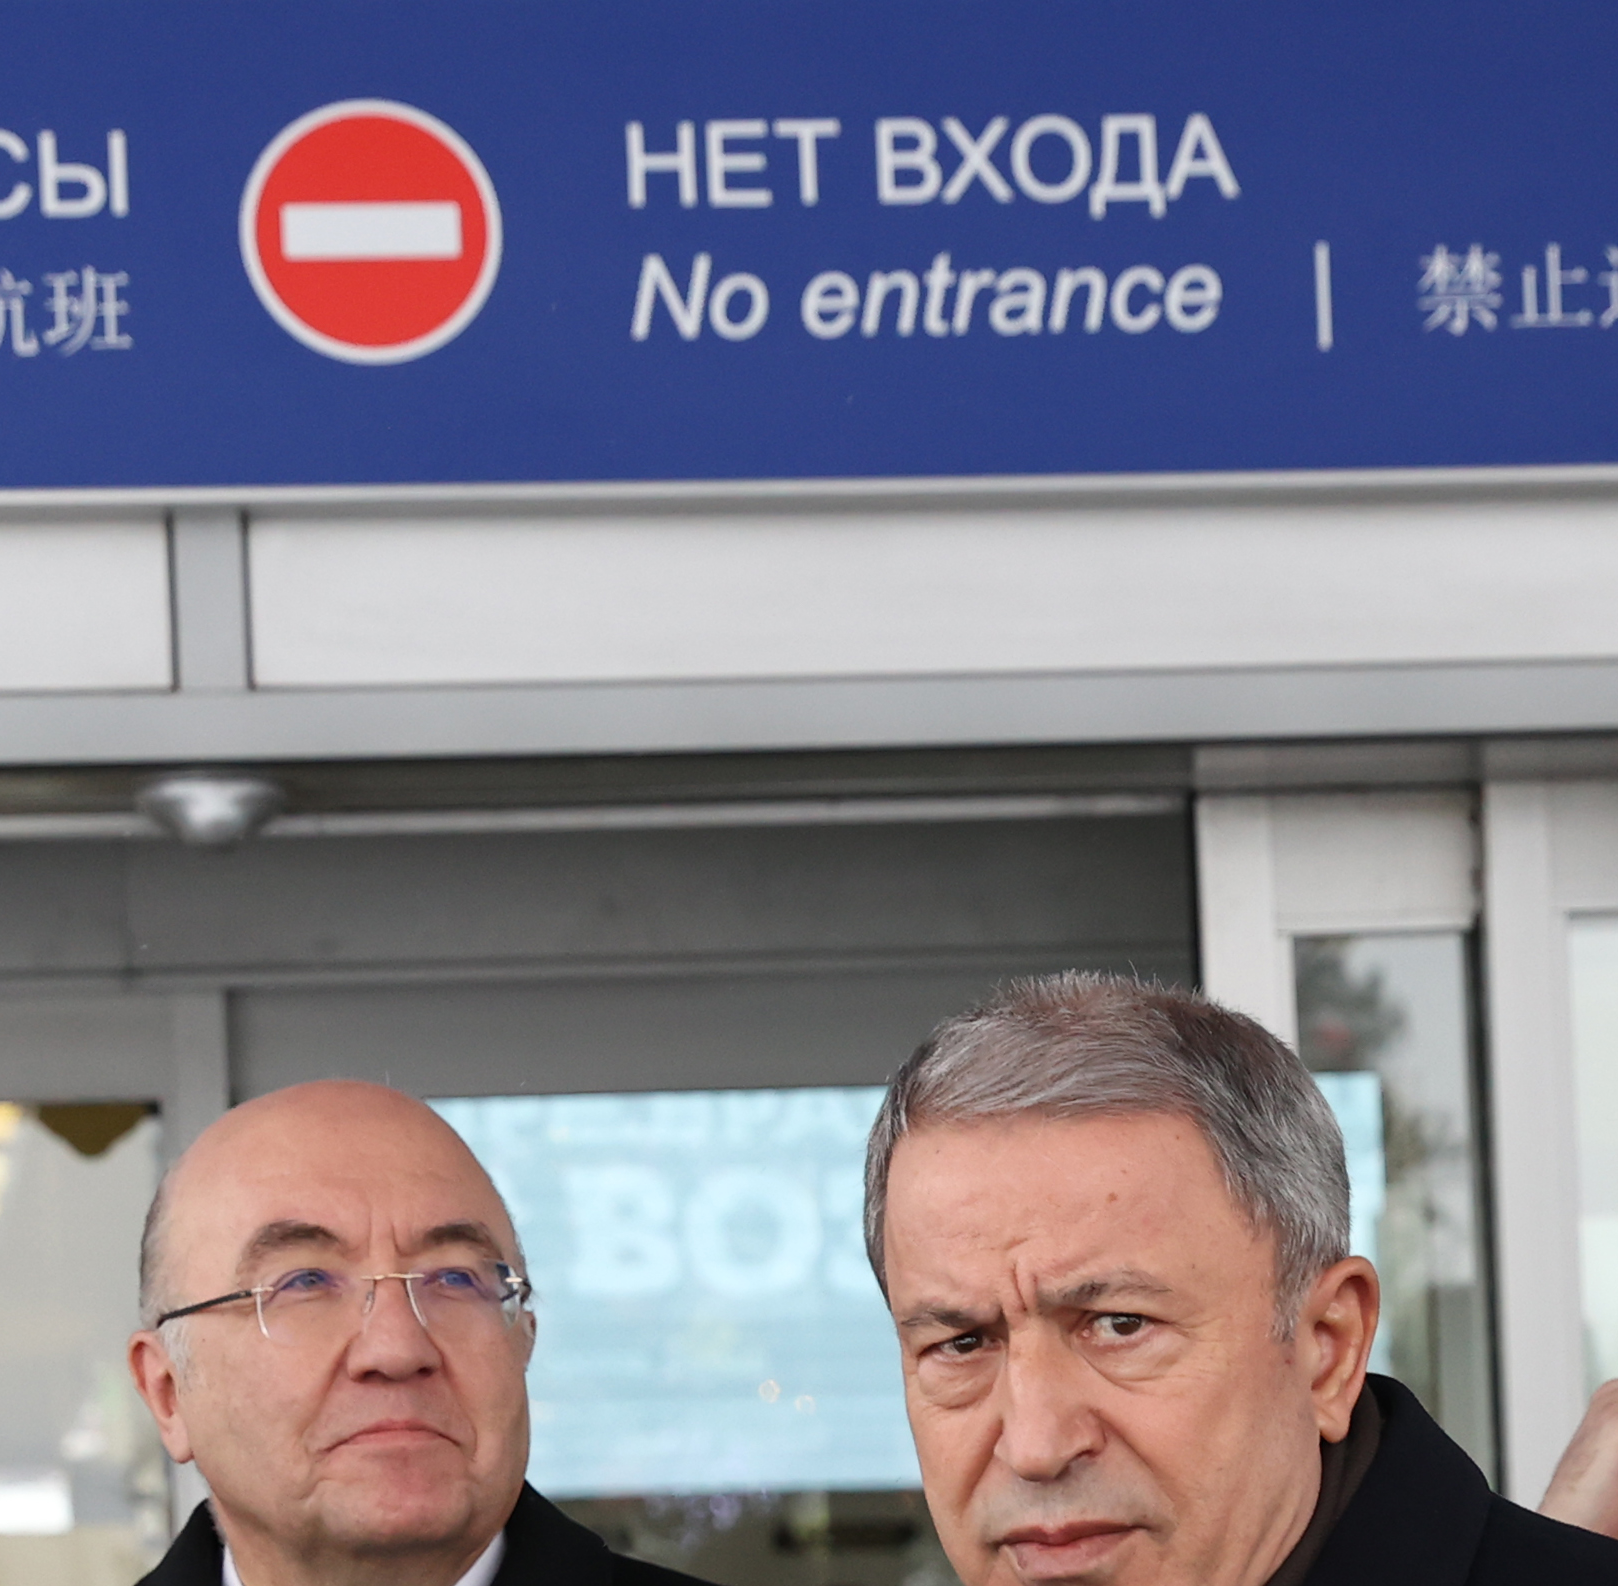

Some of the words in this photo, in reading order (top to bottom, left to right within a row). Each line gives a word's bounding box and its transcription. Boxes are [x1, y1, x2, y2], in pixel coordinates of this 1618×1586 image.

[624, 117, 842, 210] НЕТ
[874, 112, 1241, 219] ВХОДА
[629, 251, 771, 342] No
[800, 250, 1224, 340] entrance
